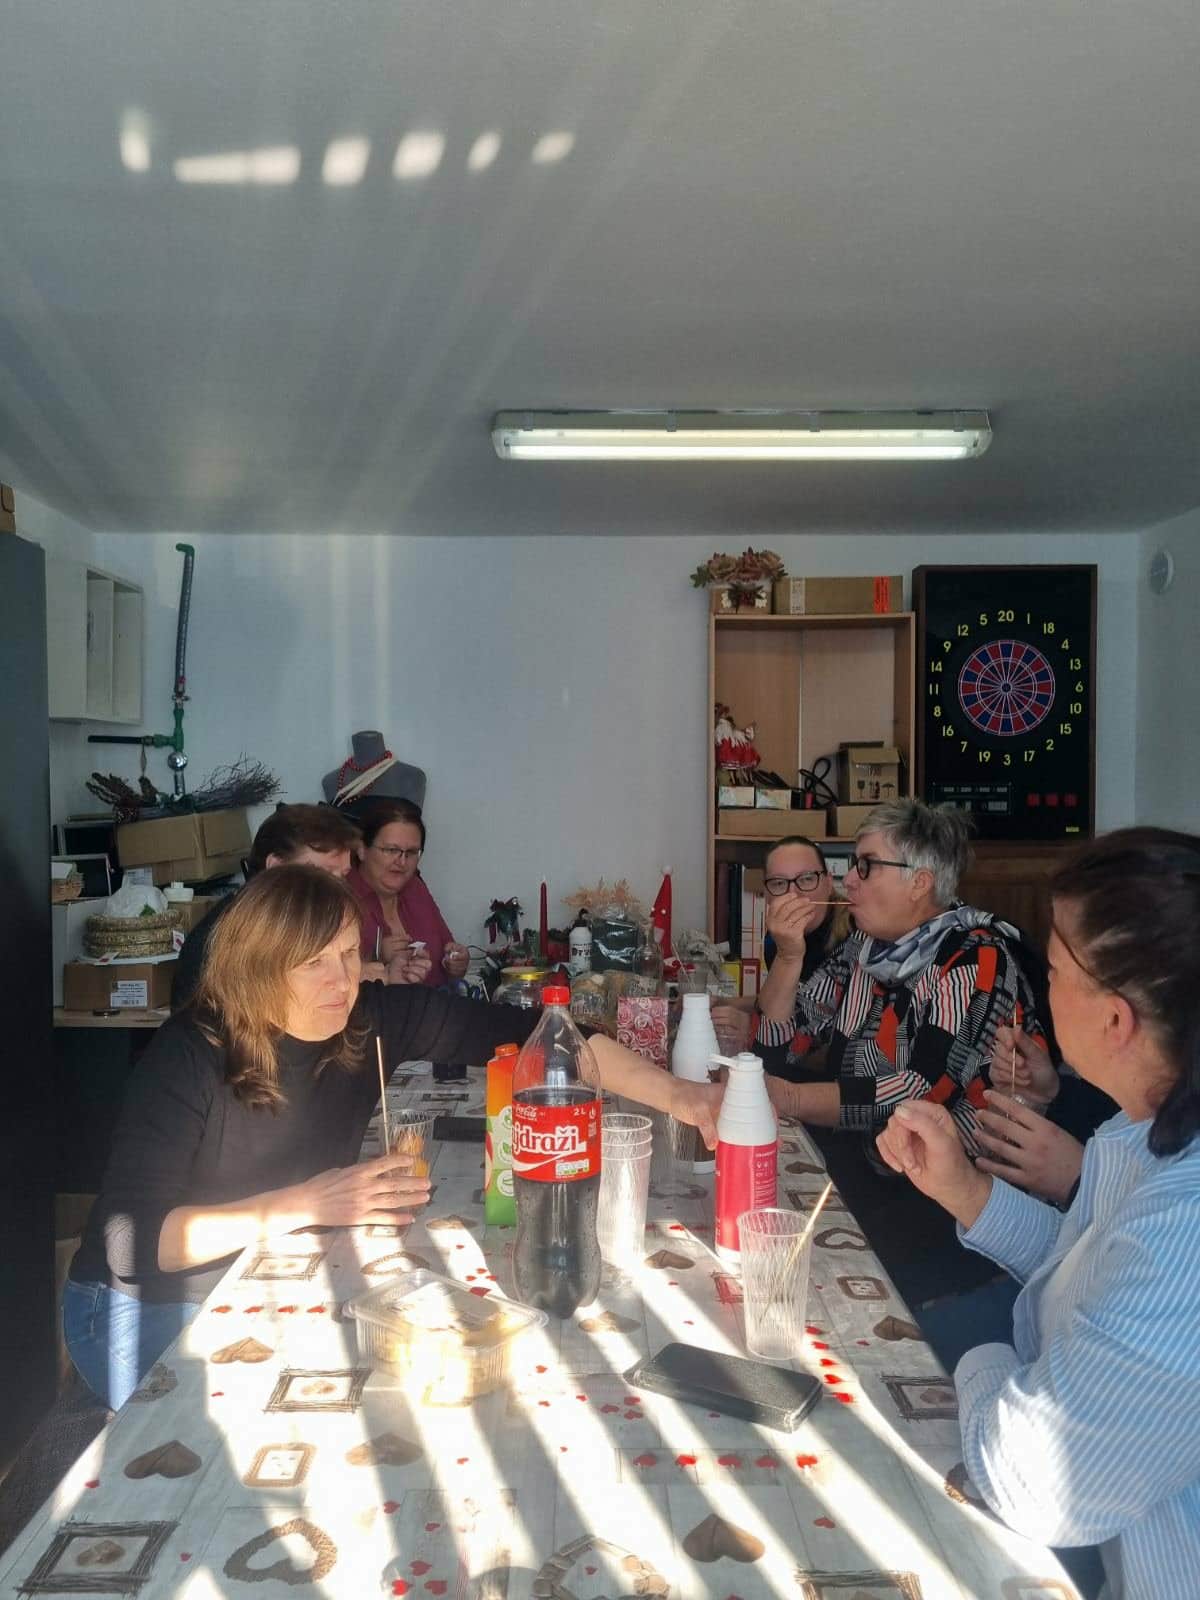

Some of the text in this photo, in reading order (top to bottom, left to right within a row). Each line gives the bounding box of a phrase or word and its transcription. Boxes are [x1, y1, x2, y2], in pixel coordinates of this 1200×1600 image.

[980, 614, 988, 625] 5
[998, 610, 1015, 622] 20
[957, 624, 969, 636] 12
[1043, 622, 1055, 634] 18
[943, 641, 951, 652] 9
[1061, 639, 1069, 650] 4
[931, 661, 942, 672] 14
[1069, 659, 1081, 670] 13
[929, 684, 938, 695] 11
[1075, 681, 1083, 692] 6
[933, 706, 941, 717] 8
[1069, 703, 1081, 714] 10
[942, 725, 954, 737] 16
[1060, 723, 1072, 735] 15
[960, 741, 968, 753] 7
[1046, 739, 1054, 751] 2
[979, 751, 990, 763] 19
[1003, 754, 1011, 766] 3
[1024, 751, 1036, 762] 17
[573, 1108, 580, 1116] 2
